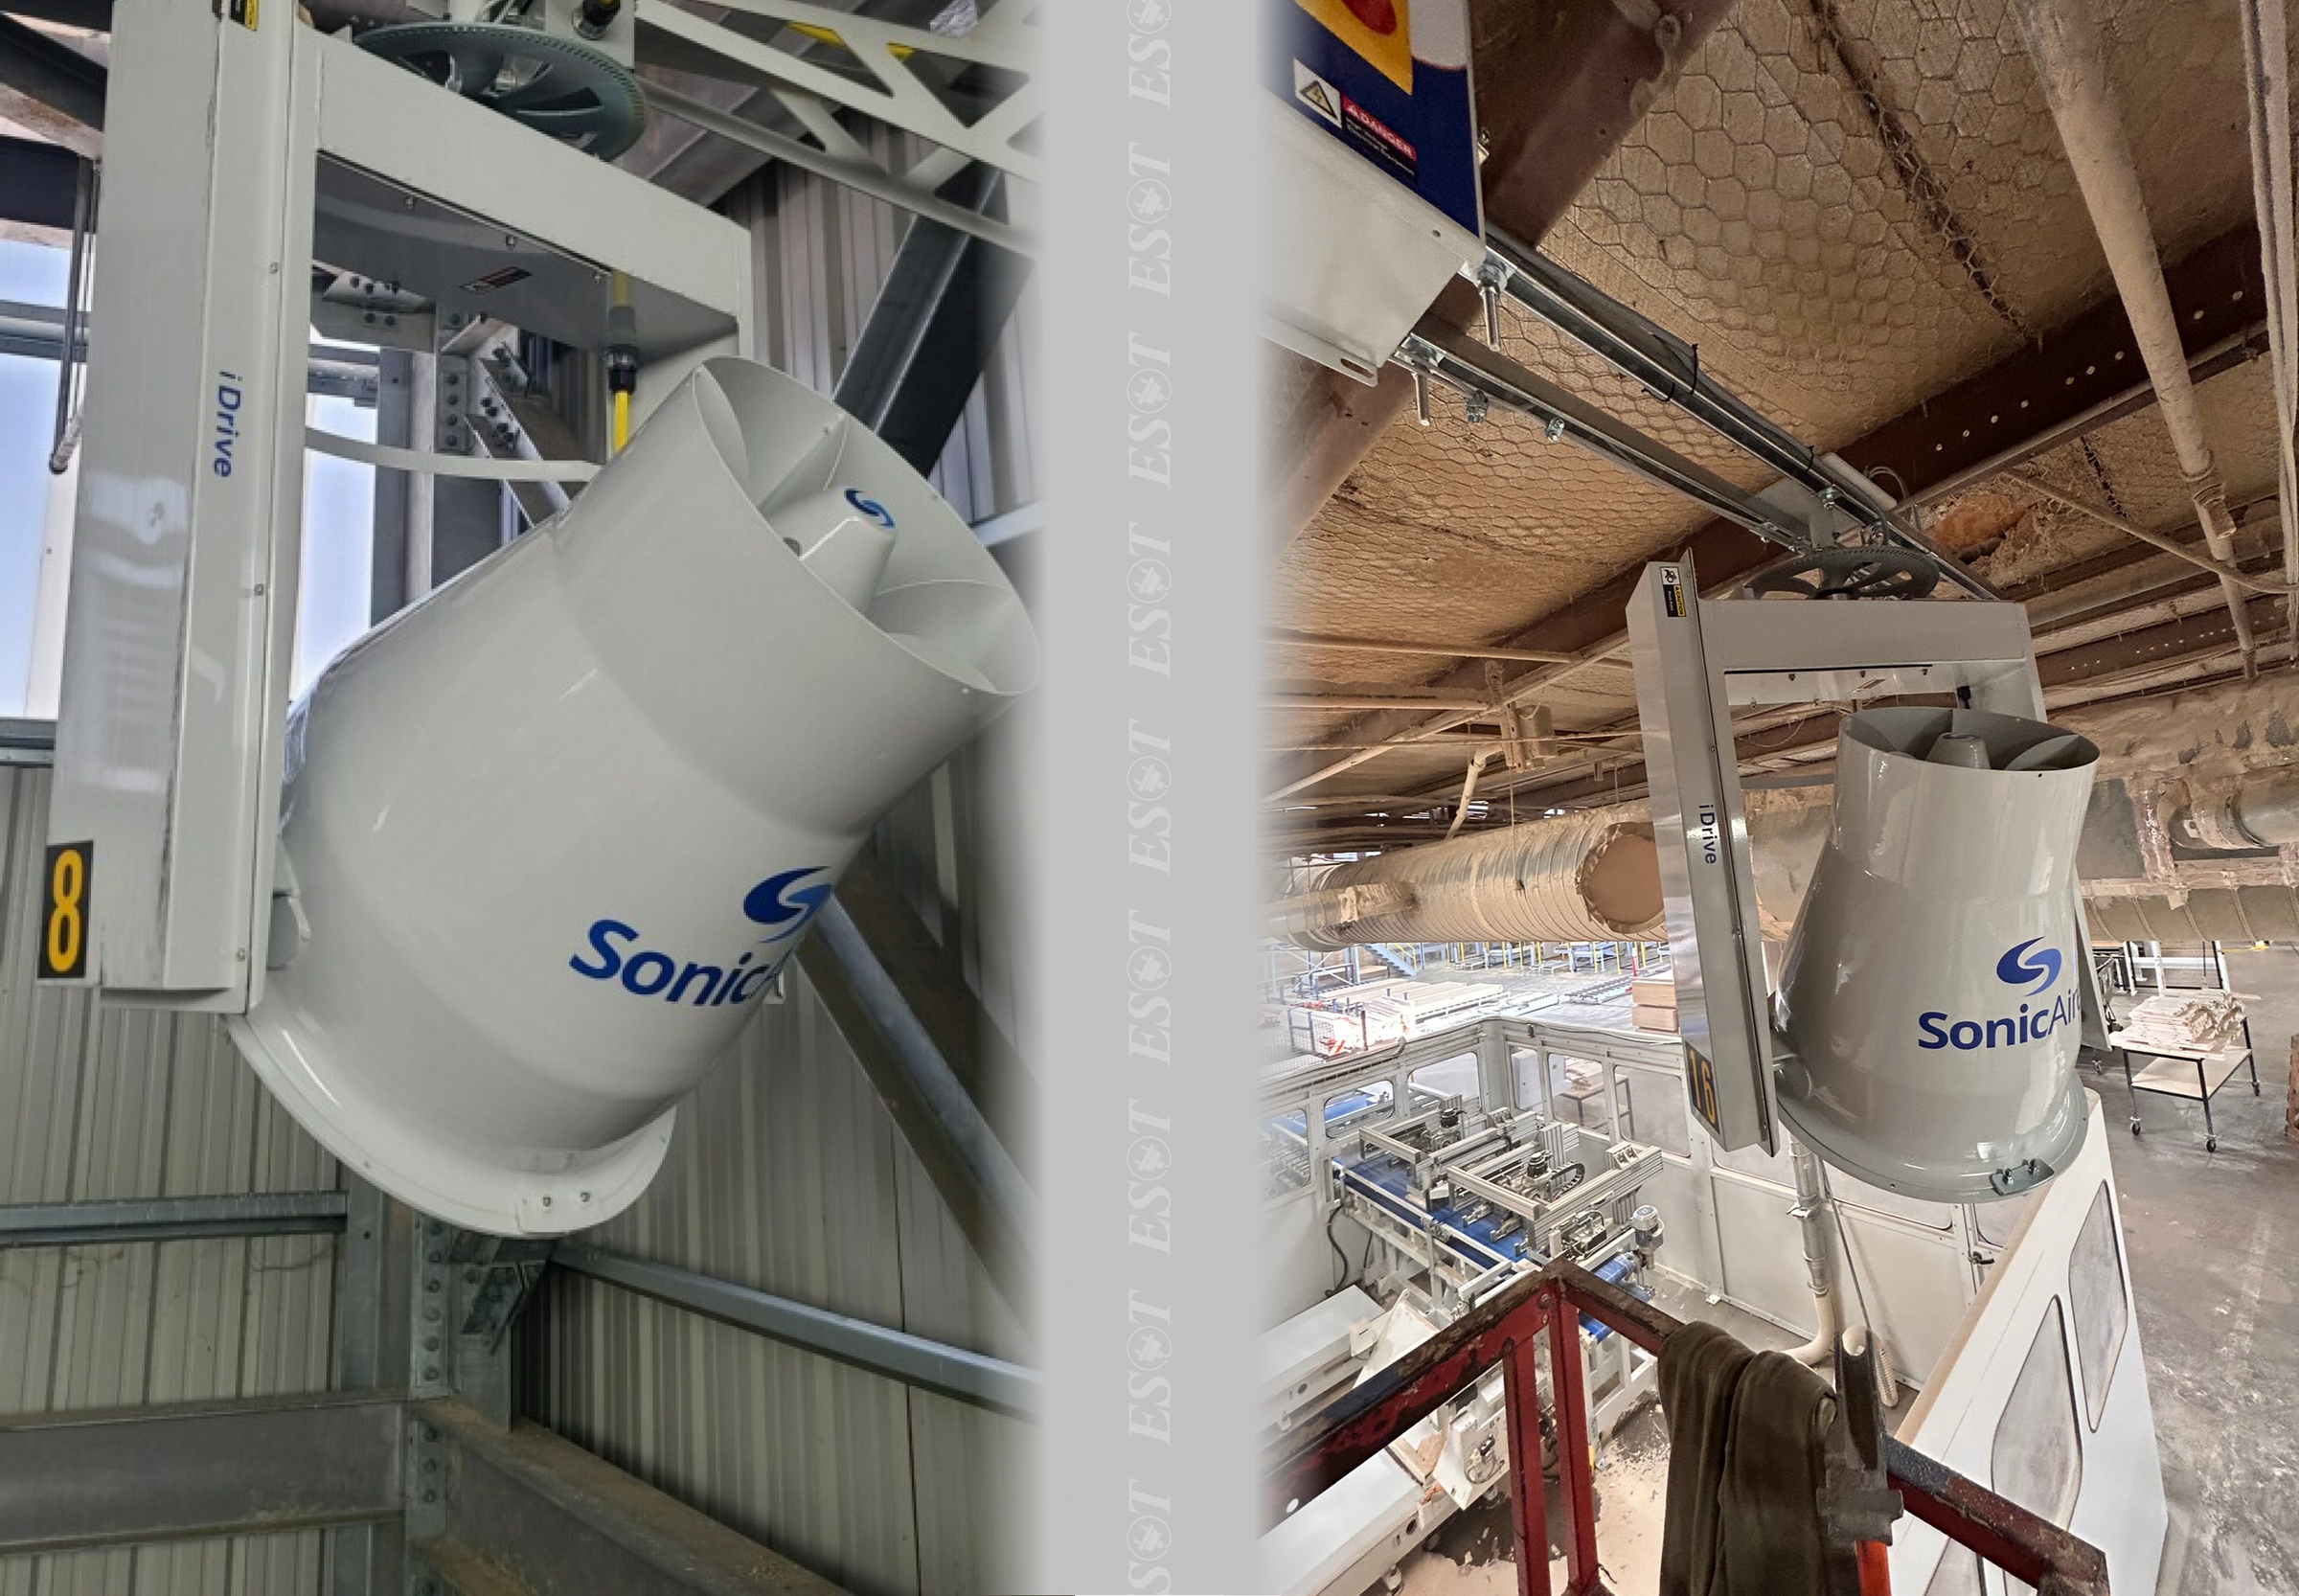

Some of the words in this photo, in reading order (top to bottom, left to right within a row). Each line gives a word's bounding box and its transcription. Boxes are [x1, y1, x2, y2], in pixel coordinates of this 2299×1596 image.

[1675, 591, 1684, 615] CAUTION
[49, 849, 82, 973] 8
[1689, 1049, 1716, 1124] 16
